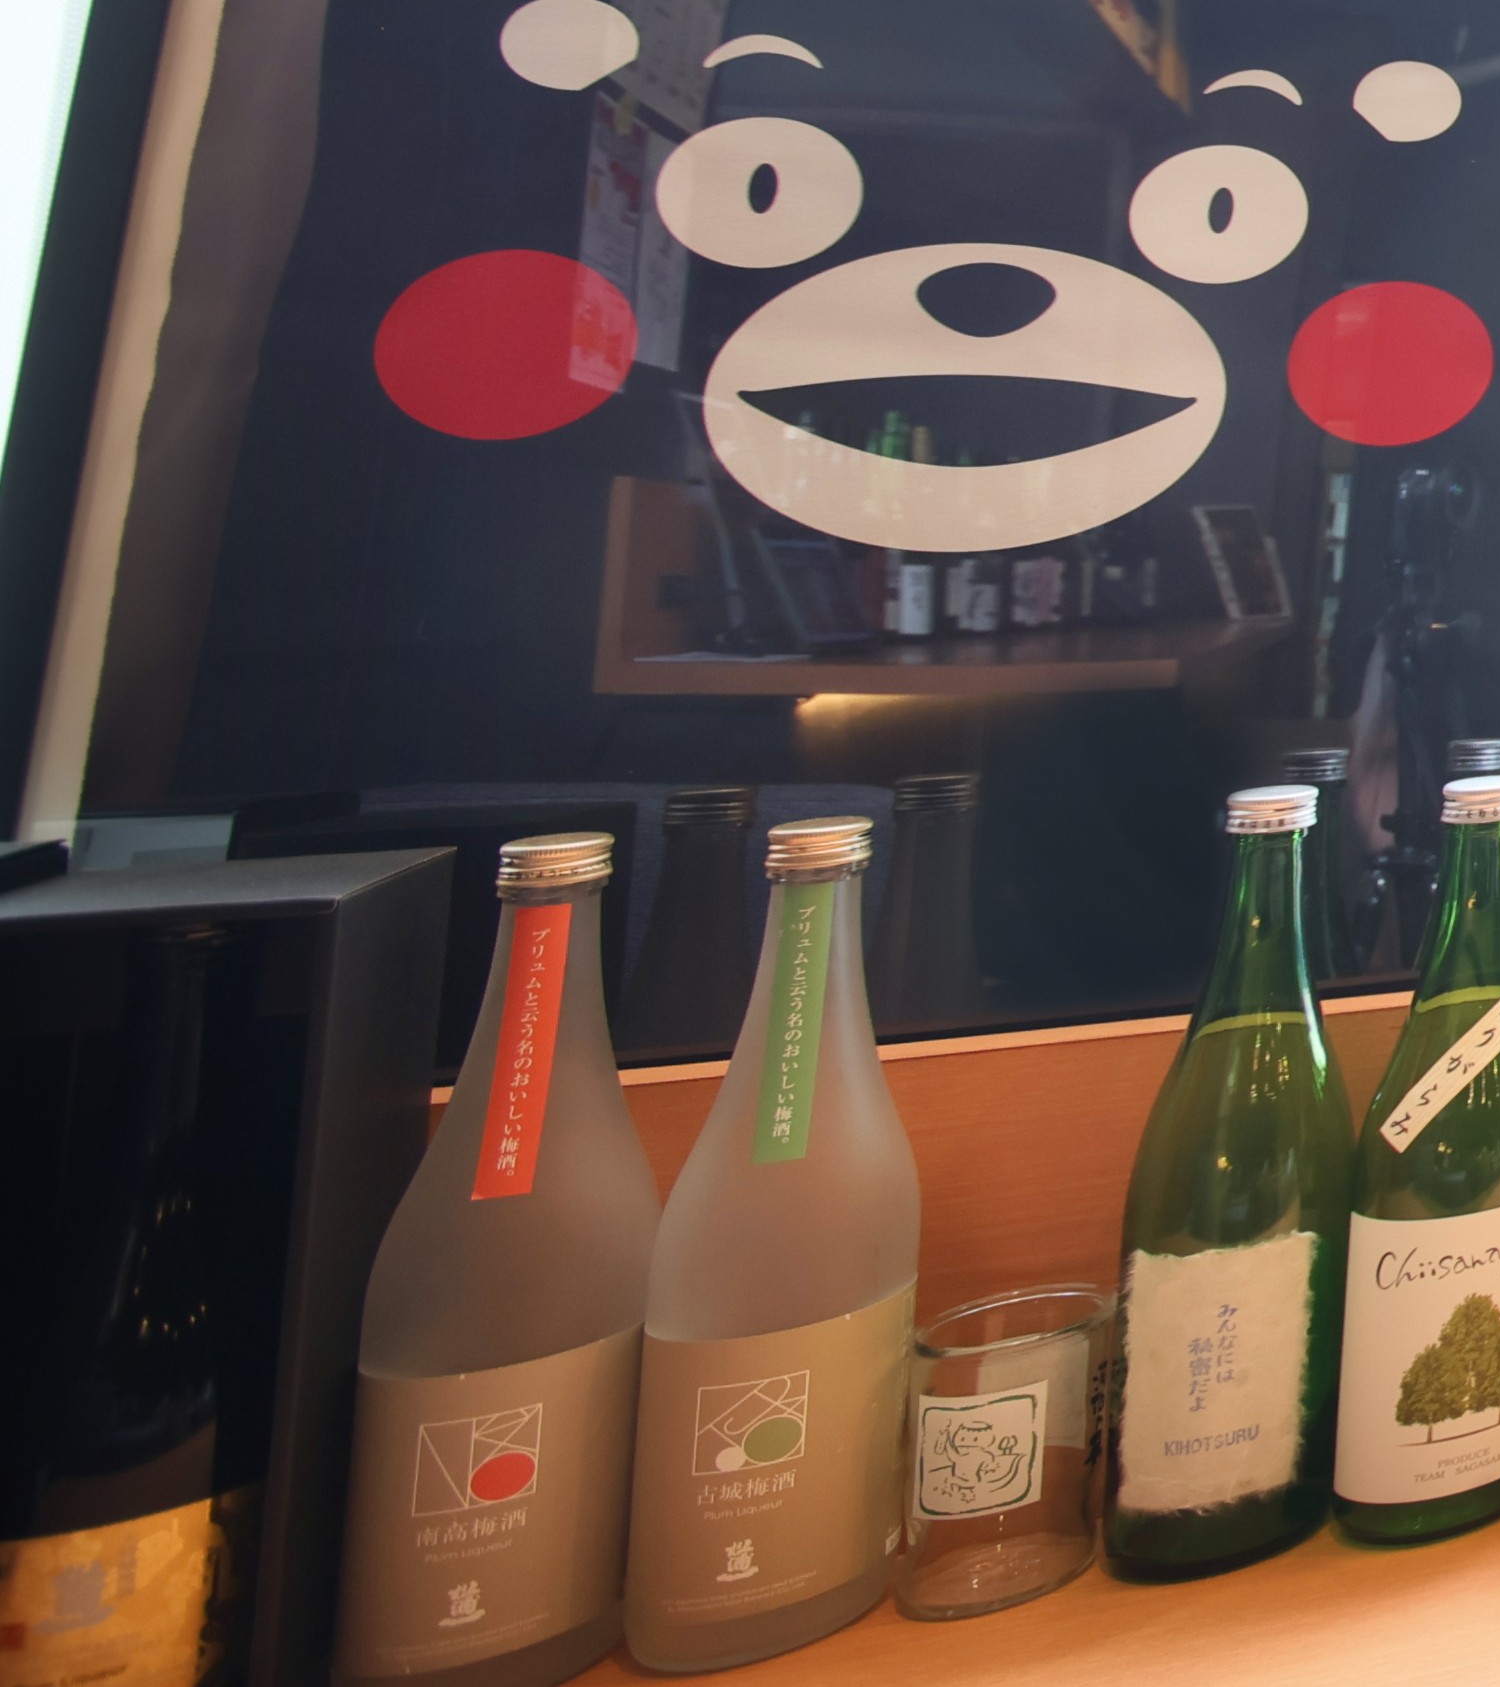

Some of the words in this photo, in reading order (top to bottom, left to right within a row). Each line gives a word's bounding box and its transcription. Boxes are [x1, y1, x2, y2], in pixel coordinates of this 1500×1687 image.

[1216, 1302, 1239, 1385] みんなには
[1187, 1336, 1214, 1413] 秘密だよ
[1164, 1423, 1261, 1458] KIHOTSURU
[1437, 1446, 1491, 1469] PRODUCE
[697, 1468, 798, 1507] 古城梅酒
[1412, 1469, 1446, 1484] TEAM
